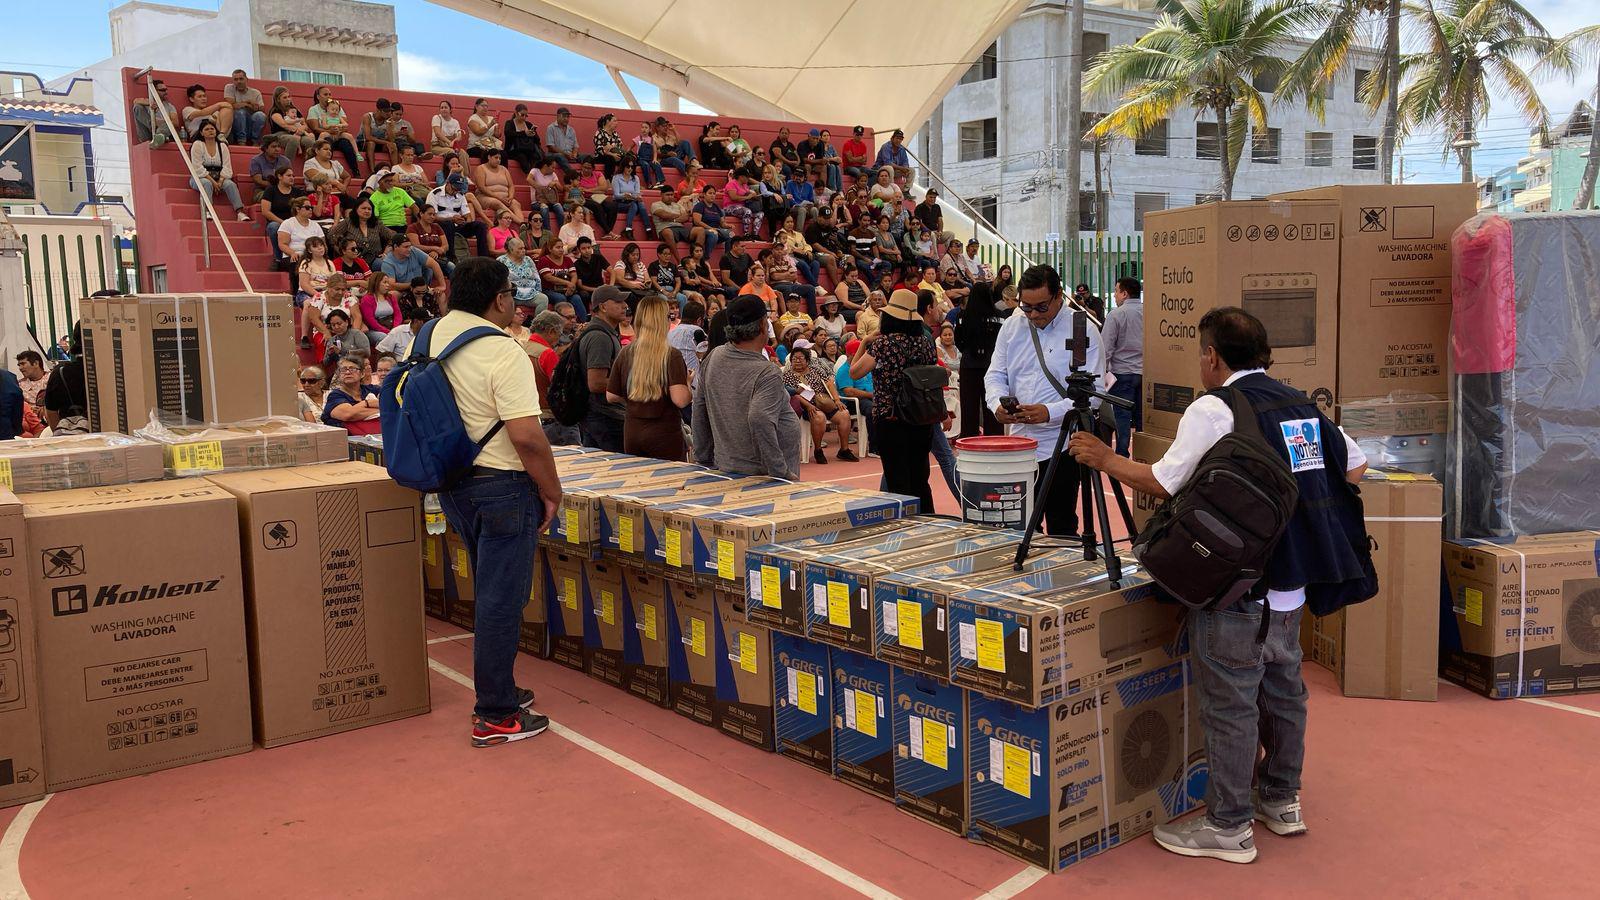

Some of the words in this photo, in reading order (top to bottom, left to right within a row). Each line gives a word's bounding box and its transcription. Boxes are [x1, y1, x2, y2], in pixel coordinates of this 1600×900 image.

[1378, 244, 1412, 252] WASHING
[1414, 243, 1448, 252] MACHINE
[1391, 253, 1433, 261] LAVADORA
[1162, 266, 1193, 284] Estufa
[1161, 294, 1194, 314] Range
[1159, 319, 1196, 338] Cocina
[801, 517, 847, 530] APPLIANCES
[331, 549, 350, 558] PARA
[326, 560, 356, 571] MANEJO
[335, 573, 348, 581] DEL
[93, 578, 221, 607] Koblenz
[1502, 589, 1560, 598] ACONICIONADO
[325, 595, 361, 607] APOYARSE
[1502, 597, 1537, 605] MINISLIT
[329, 610, 339, 618] EN
[341, 608, 358, 617] ESTA
[90, 617, 144, 634] WASHING
[146, 610, 195, 627] MACHINE
[335, 620, 354, 629] ZONA
[113, 624, 176, 642] LAVADORA
[1052, 624, 1095, 642] ACNDICIONADO
[126, 660, 160, 671] DEJARSE
[161, 656, 181, 665] CAER
[792, 658, 824, 675] GREE
[1041, 656, 1055, 665] SOLO
[101, 677, 121, 686] DEBE
[123, 670, 168, 684] MANEJARSE
[169, 665, 193, 675] ENTRE
[319, 671, 333, 679] NO
[335, 663, 375, 677] ACOSTAR
[144, 675, 184, 689] PERSONAS
[849, 675, 885, 694] GREE
[1143, 672, 1166, 688] SEER
[117, 708, 134, 717] NO
[136, 698, 183, 714] ACOSTAR
[1070, 691, 1110, 716] GREE
[913, 701, 956, 723] GREE
[995, 726, 1042, 753] GREE
[1056, 732, 1069, 744] AIRE
[1057, 767, 1073, 778] SOLO
